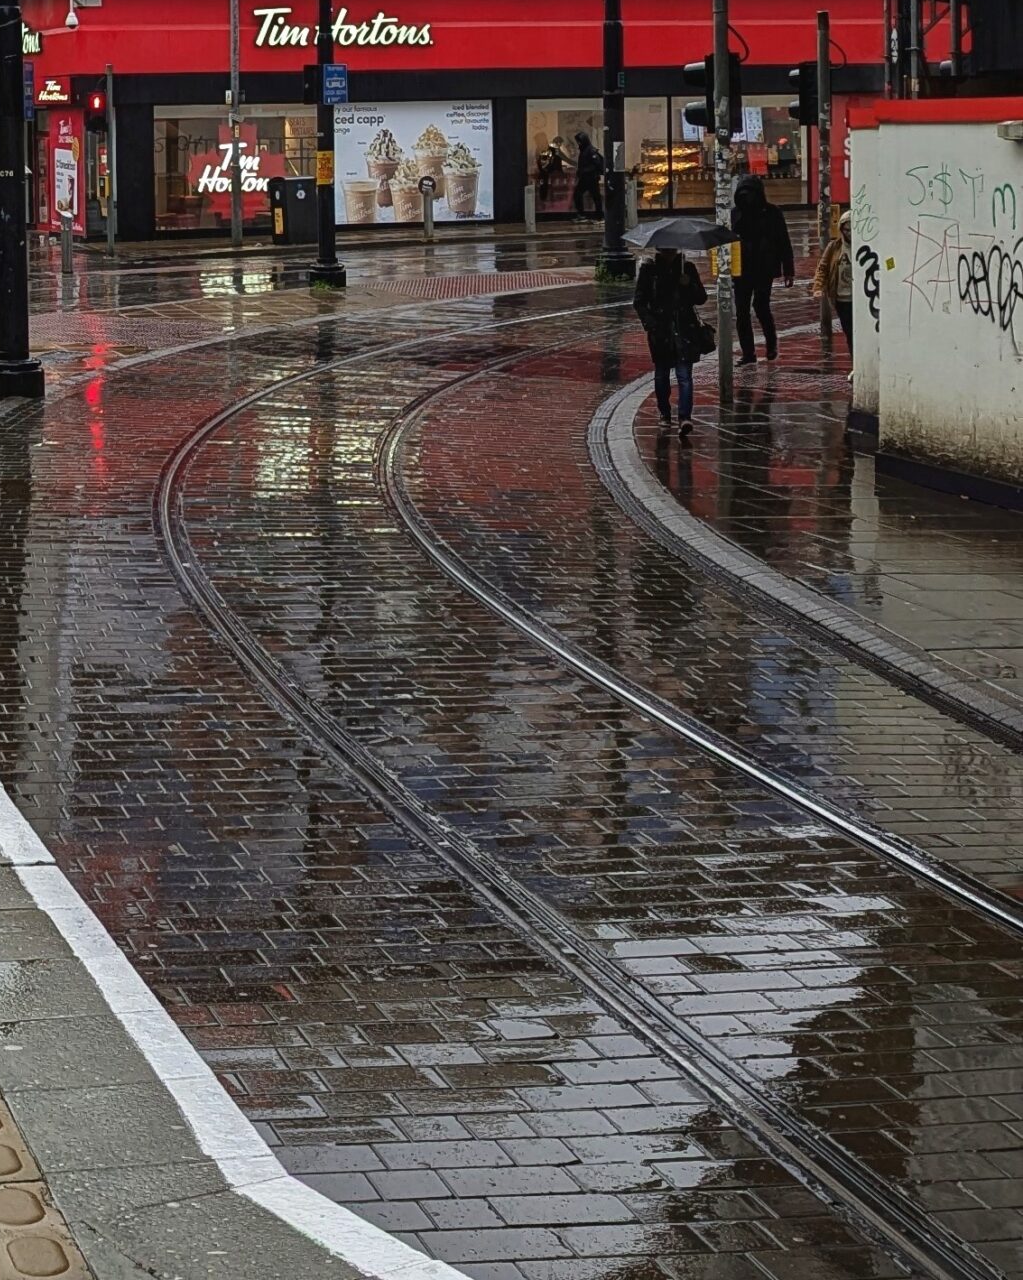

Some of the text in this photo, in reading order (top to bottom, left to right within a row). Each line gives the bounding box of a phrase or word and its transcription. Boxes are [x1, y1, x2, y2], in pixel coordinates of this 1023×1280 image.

[254, 8, 310, 46] Tim
[45, 81, 61, 91] Tim
[38, 91, 68, 101] Hortons
[334, 113, 355, 124] ced
[219, 142, 260, 171] Tm
